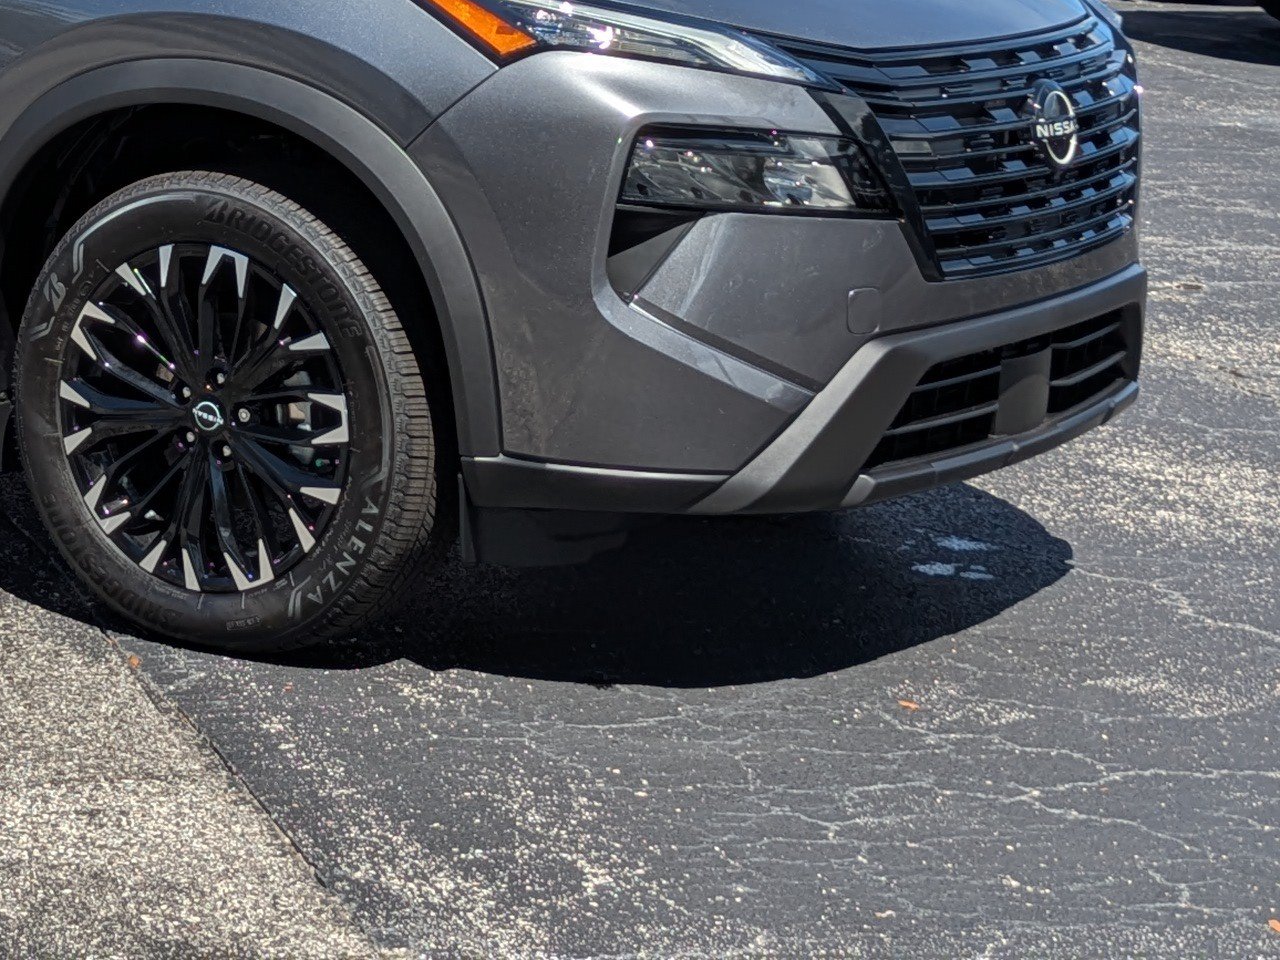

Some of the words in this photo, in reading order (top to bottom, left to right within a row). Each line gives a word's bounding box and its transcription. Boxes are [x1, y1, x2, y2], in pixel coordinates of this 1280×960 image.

[1035, 120, 1080, 139] NISSA
[202, 197, 363, 339] BRIDGESTONE
[306, 496, 380, 605] ALENZA
